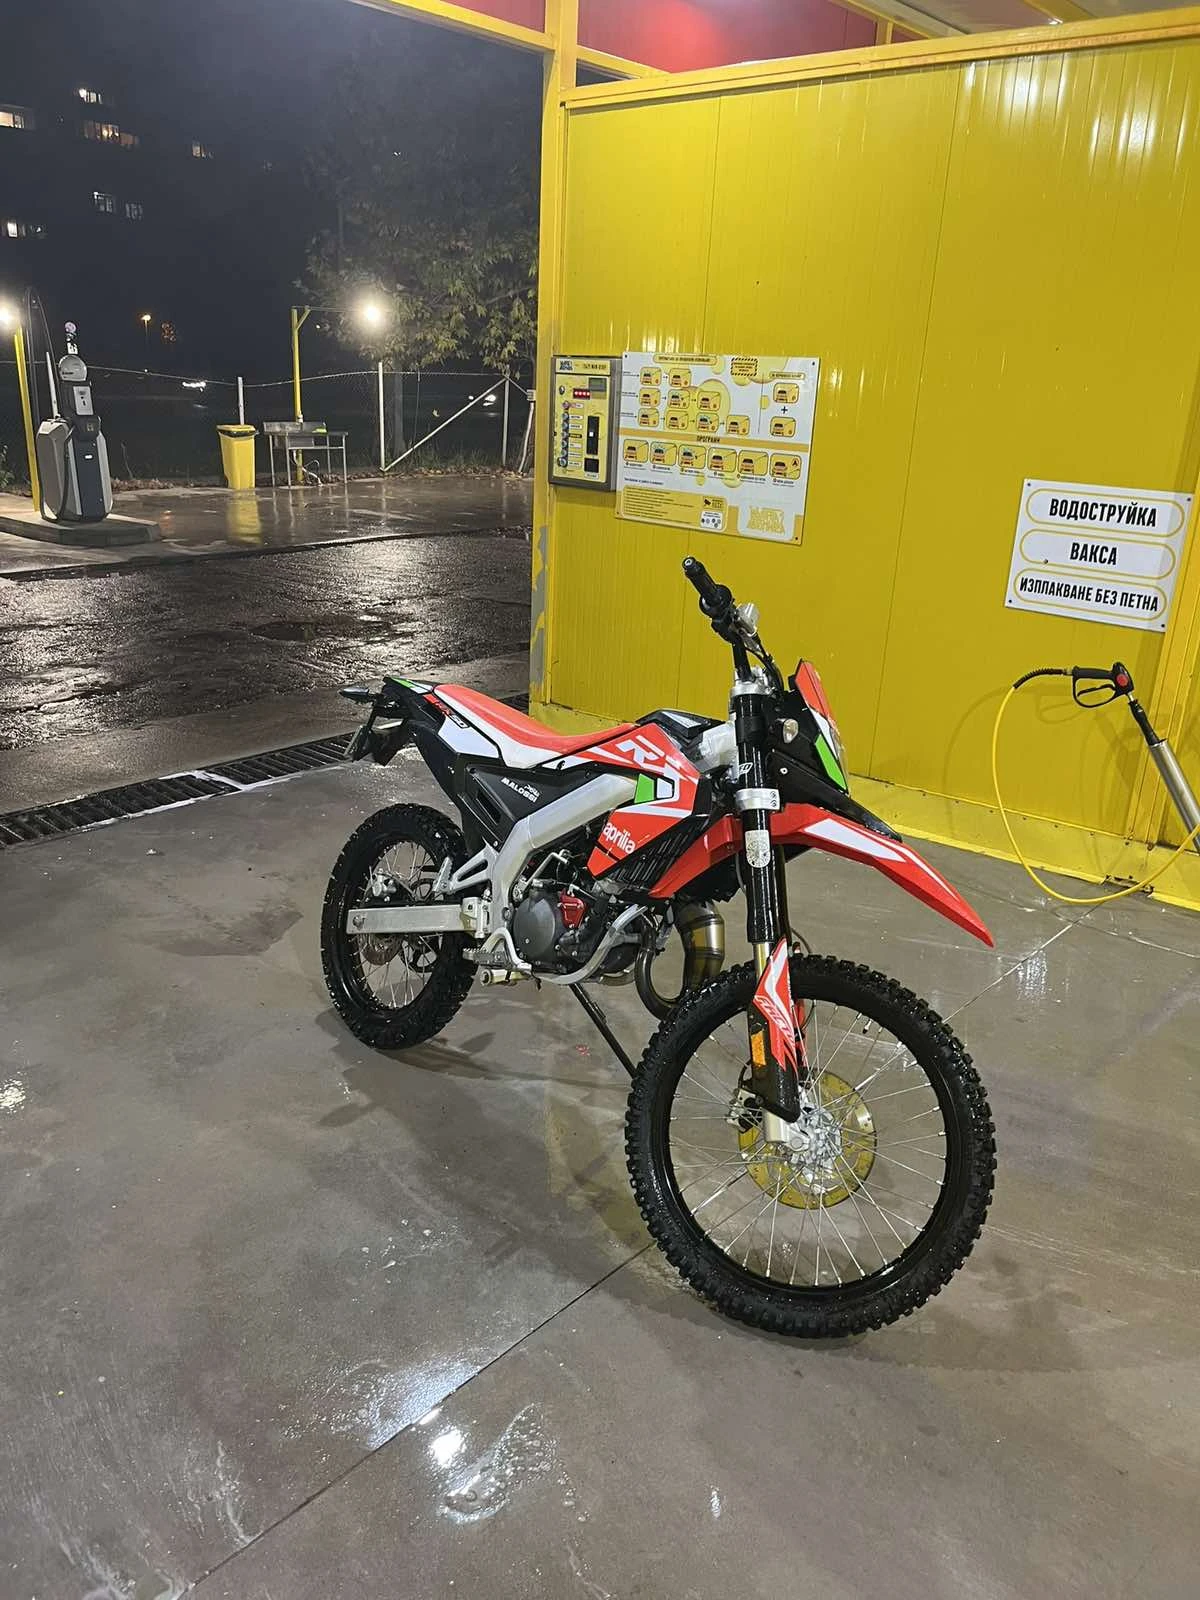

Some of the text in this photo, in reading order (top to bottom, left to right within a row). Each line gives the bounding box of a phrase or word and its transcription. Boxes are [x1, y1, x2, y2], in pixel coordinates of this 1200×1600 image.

[1049, 498, 1157, 527] ВОДОСТРУЙКА
[1069, 542, 1118, 565] ВАКСА
[1019, 577, 1158, 612] ИЗПЛАКВАНЕ БЕЗ ПЕТНА
[501, 777, 538, 803] MALOSSI
[602, 822, 636, 854] aprilia
